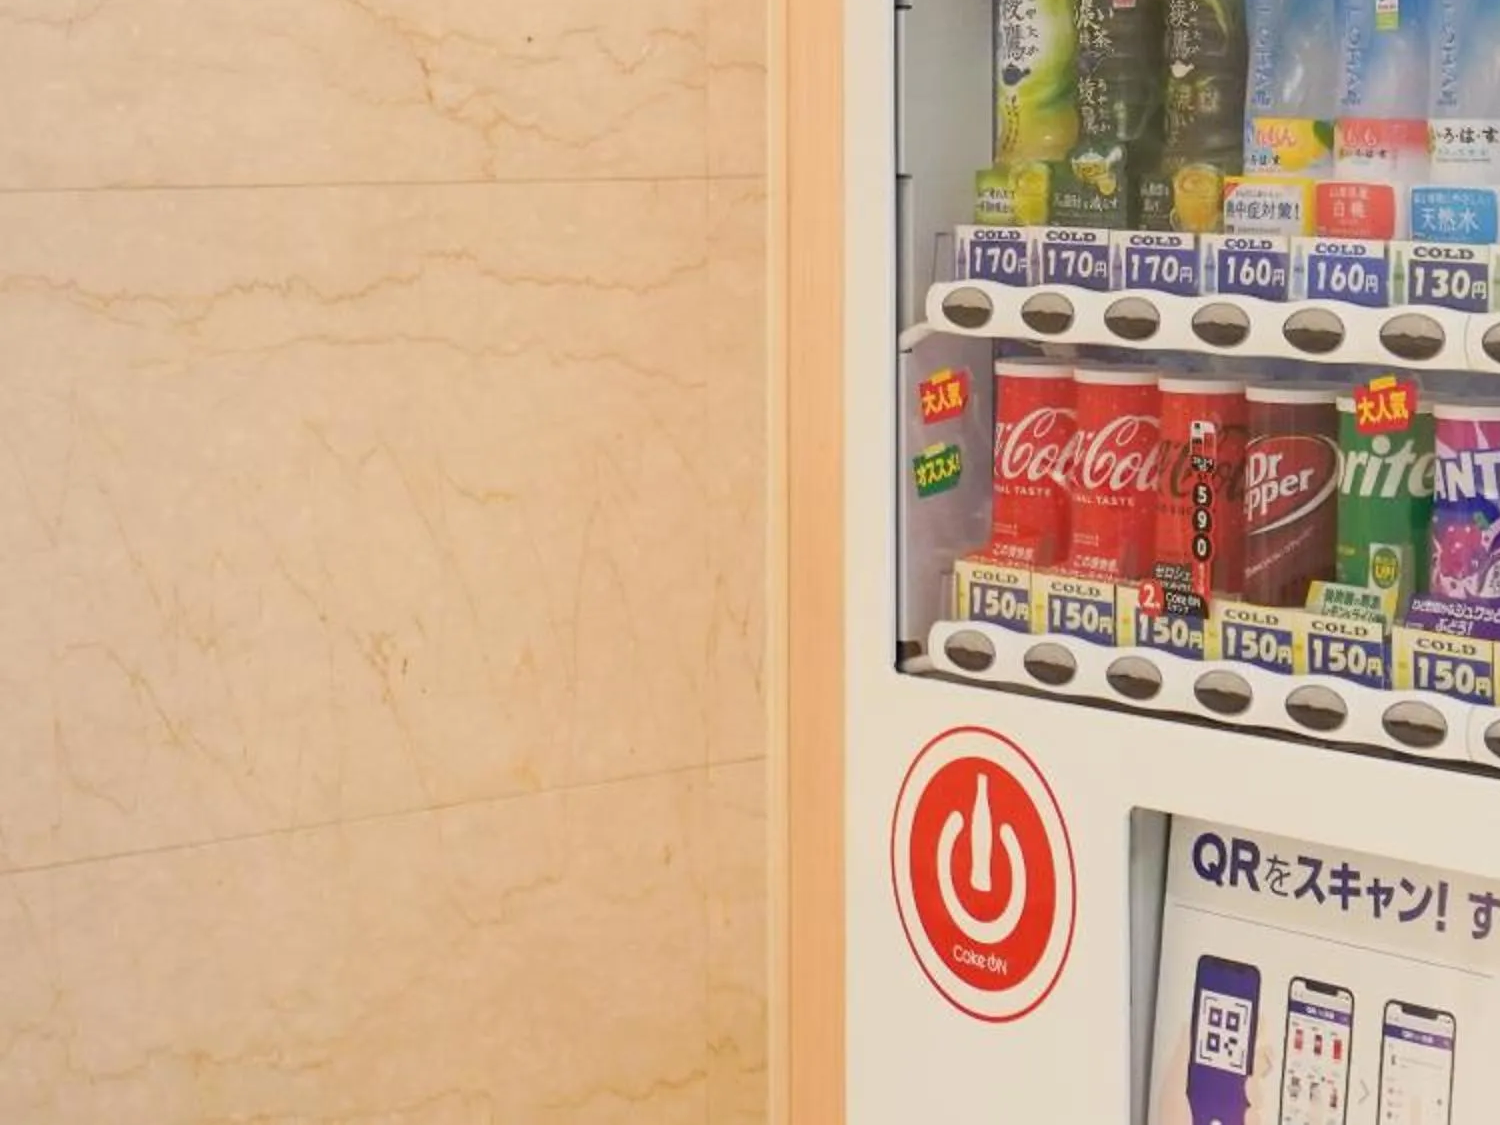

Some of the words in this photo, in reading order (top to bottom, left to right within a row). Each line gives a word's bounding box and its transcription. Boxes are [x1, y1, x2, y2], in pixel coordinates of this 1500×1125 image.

[974, 229, 1022, 241] COLD
[1419, 208, 1480, 233] 天然水
[1047, 249, 1108, 278] 170円
[1315, 242, 1367, 256] COLD
[1130, 253, 1194, 284] 170円
[1226, 255, 1286, 287] 160円
[1316, 260, 1379, 294] 160円
[1412, 266, 1488, 300] 130円
[922, 386, 961, 416] 大人気
[1357, 390, 1409, 425] 大人気
[915, 452, 961, 486] オススメ!
[971, 569, 1019, 584] COLD
[971, 586, 1029, 620] 150円
[1051, 599, 1114, 635] 150円
[1137, 617, 1203, 650] 150円
[1226, 626, 1293, 664] 150円
[1416, 637, 1478, 655] COLD
[1312, 641, 1383, 677] 150円
[1417, 659, 1492, 697] 150円
[1192, 831, 1450, 933] QRをスキャン!
